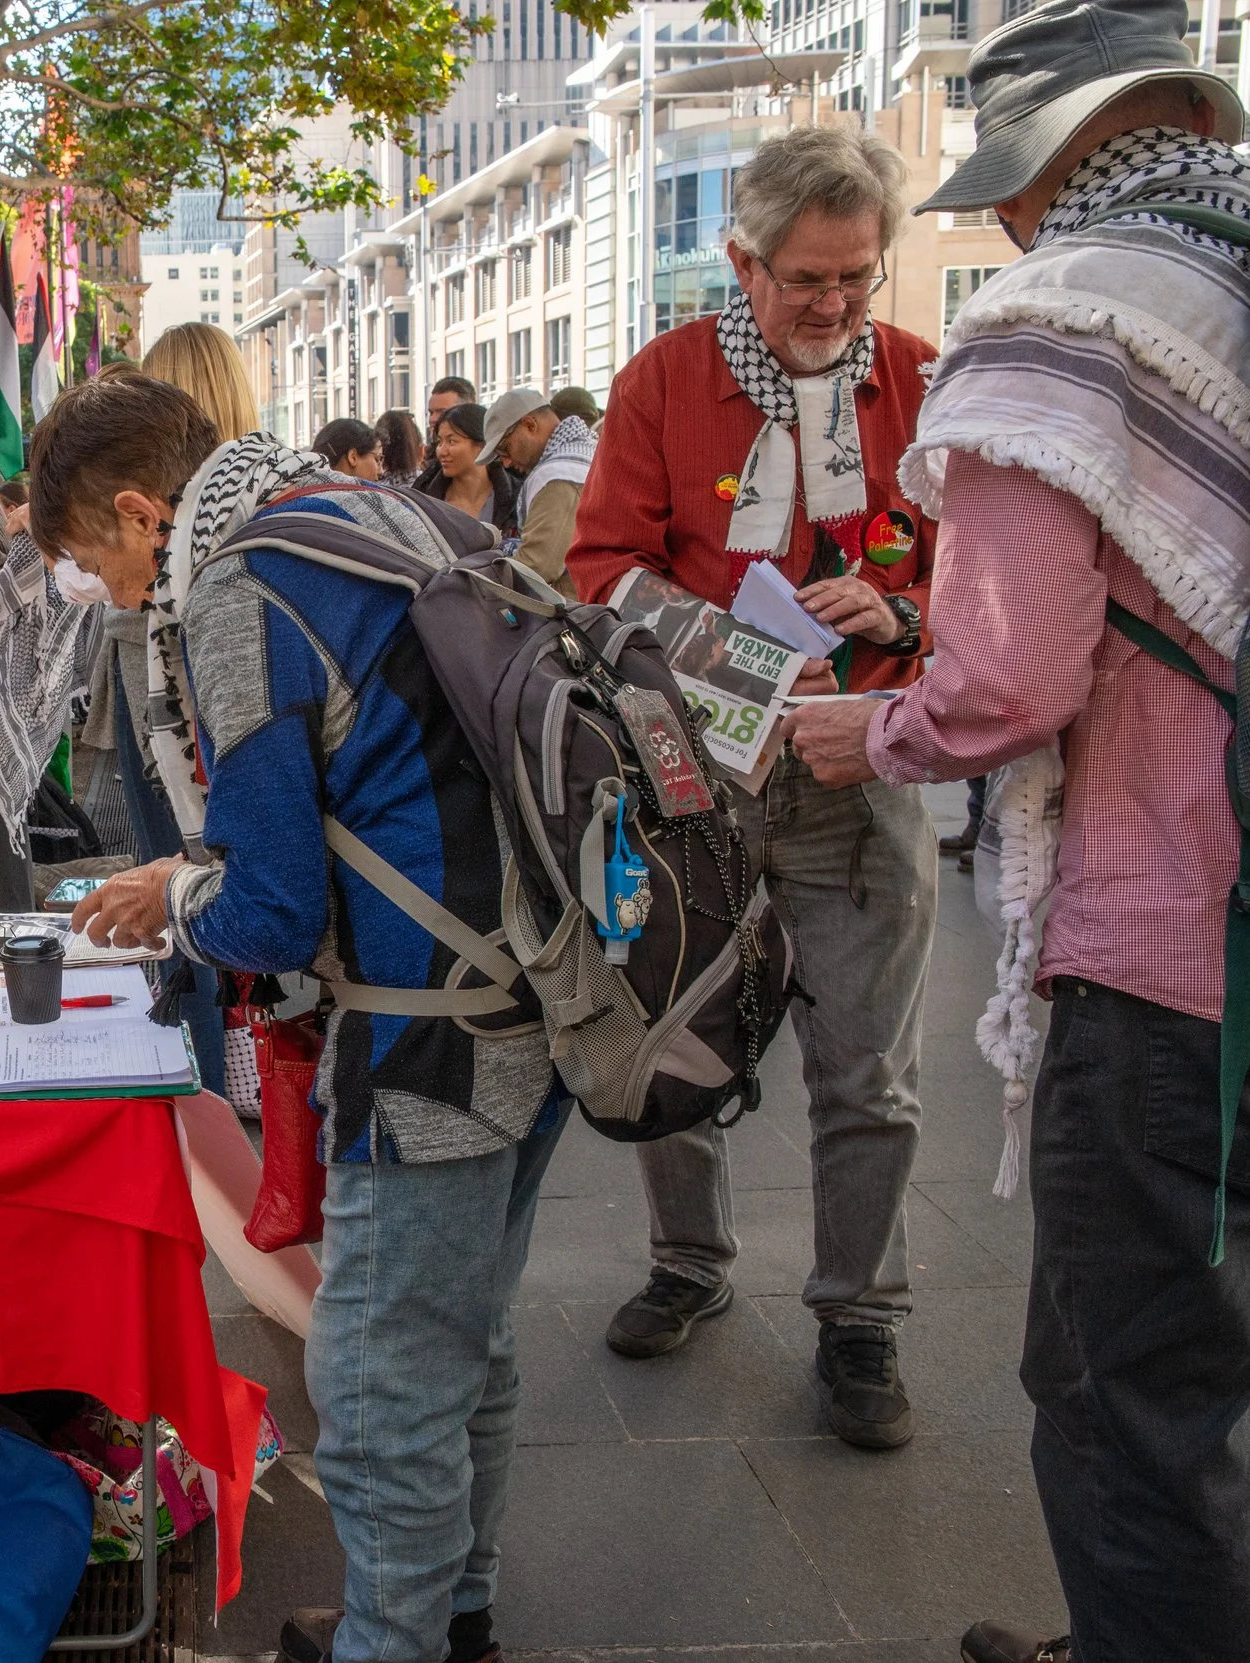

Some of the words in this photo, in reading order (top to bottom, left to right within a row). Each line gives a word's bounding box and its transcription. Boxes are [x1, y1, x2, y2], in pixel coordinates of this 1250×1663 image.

[879, 523, 904, 537] Free
[868, 535, 914, 553] Palestine
[732, 634, 790, 668] NAKBA
[733, 653, 755, 670] THE
[757, 663, 782, 680] END
[735, 748, 749, 759] For
